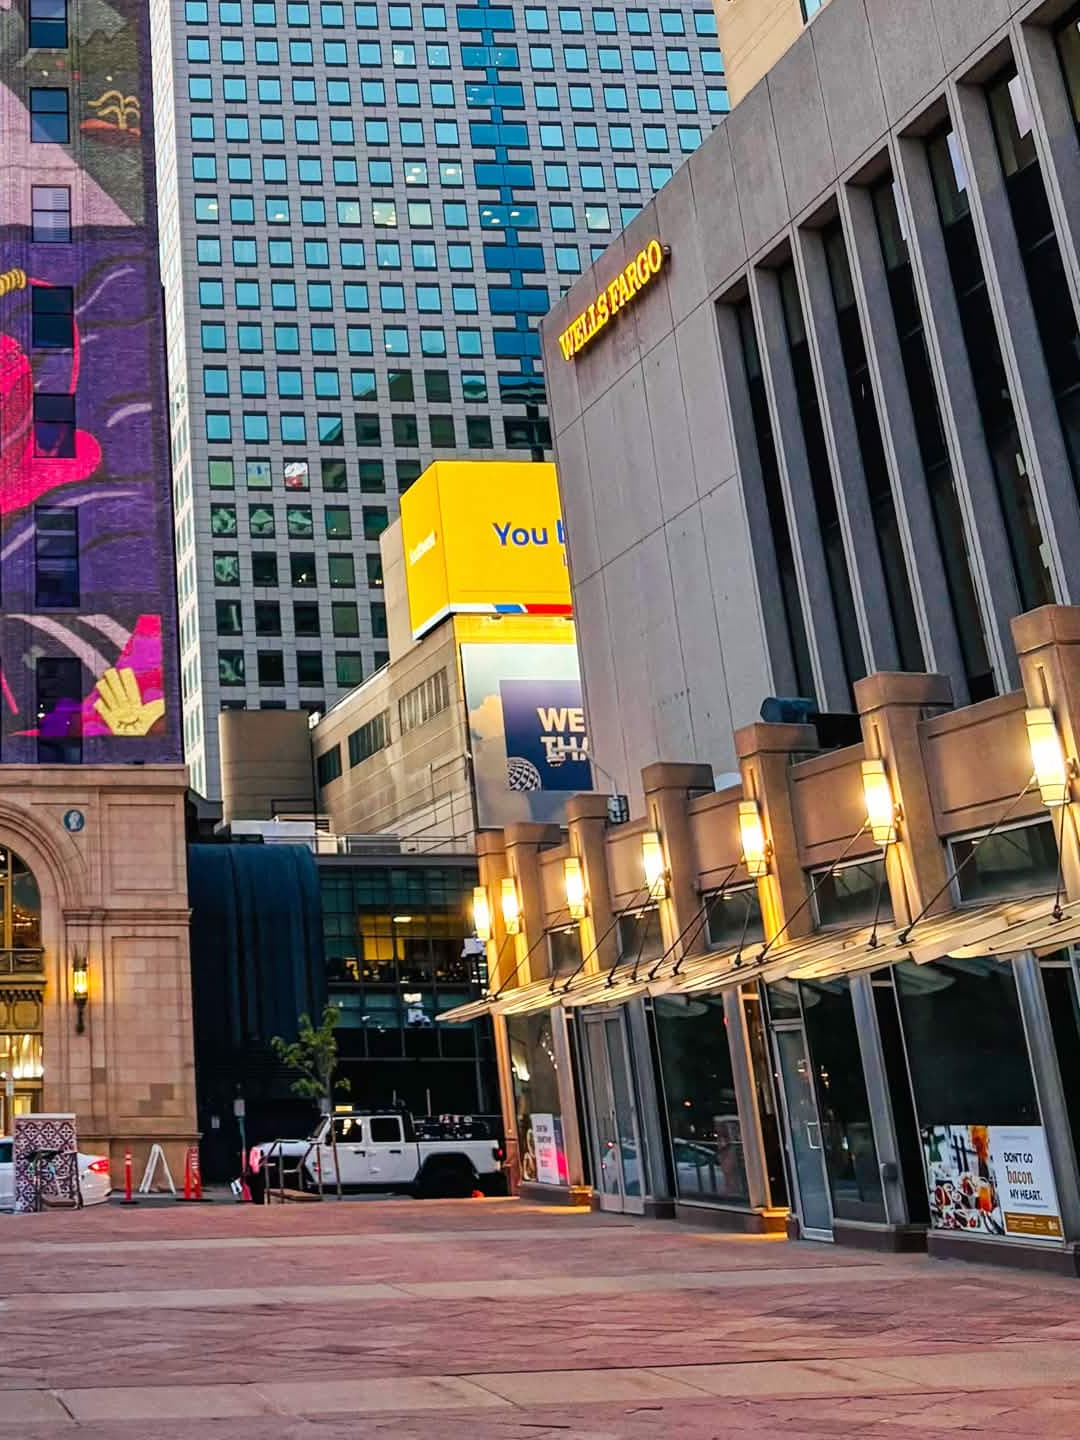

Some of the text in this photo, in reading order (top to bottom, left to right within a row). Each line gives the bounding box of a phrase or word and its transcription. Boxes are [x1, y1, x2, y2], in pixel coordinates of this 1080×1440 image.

[558, 239, 662, 361] WELLS FARGO
[493, 521, 548, 546] You
[536, 707, 585, 733] WE
[1005, 1165, 1034, 1185] bacon
